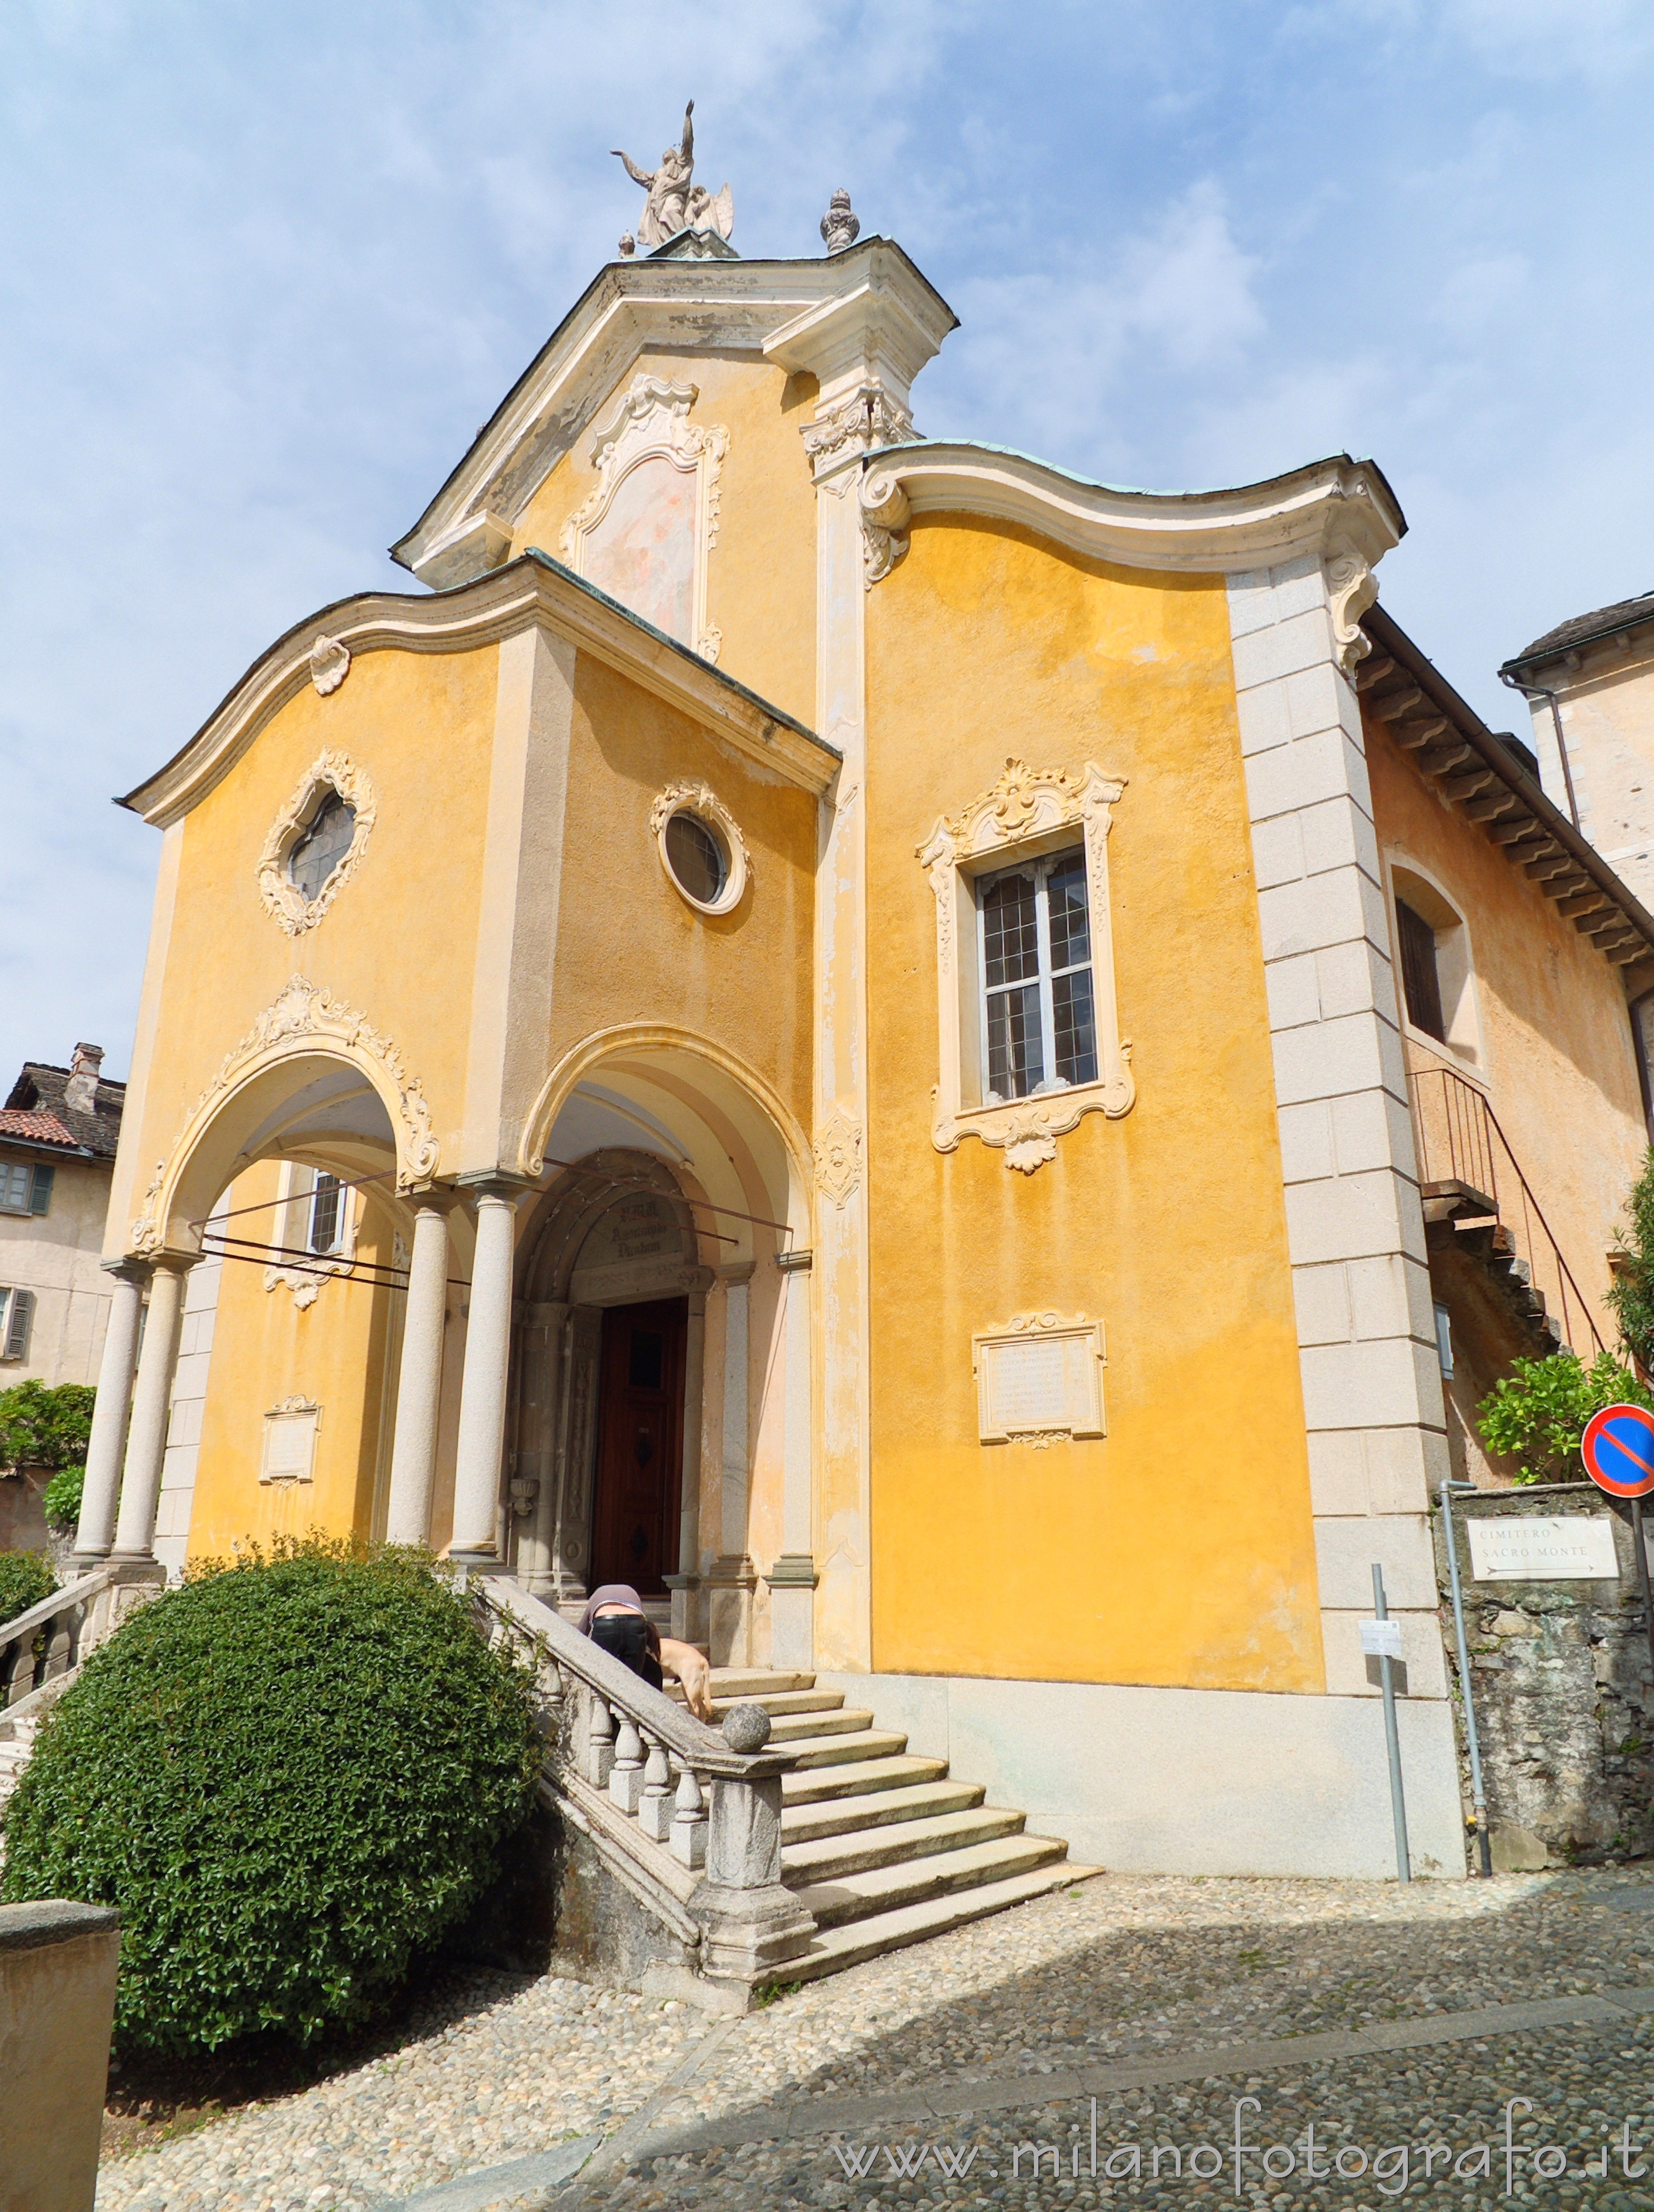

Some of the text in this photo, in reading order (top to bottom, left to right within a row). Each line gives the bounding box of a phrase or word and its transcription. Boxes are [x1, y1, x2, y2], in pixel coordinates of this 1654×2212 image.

[1480, 1529, 1551, 1539] CIMITERO
[1482, 1547, 1588, 1558] SACRO MONTE
